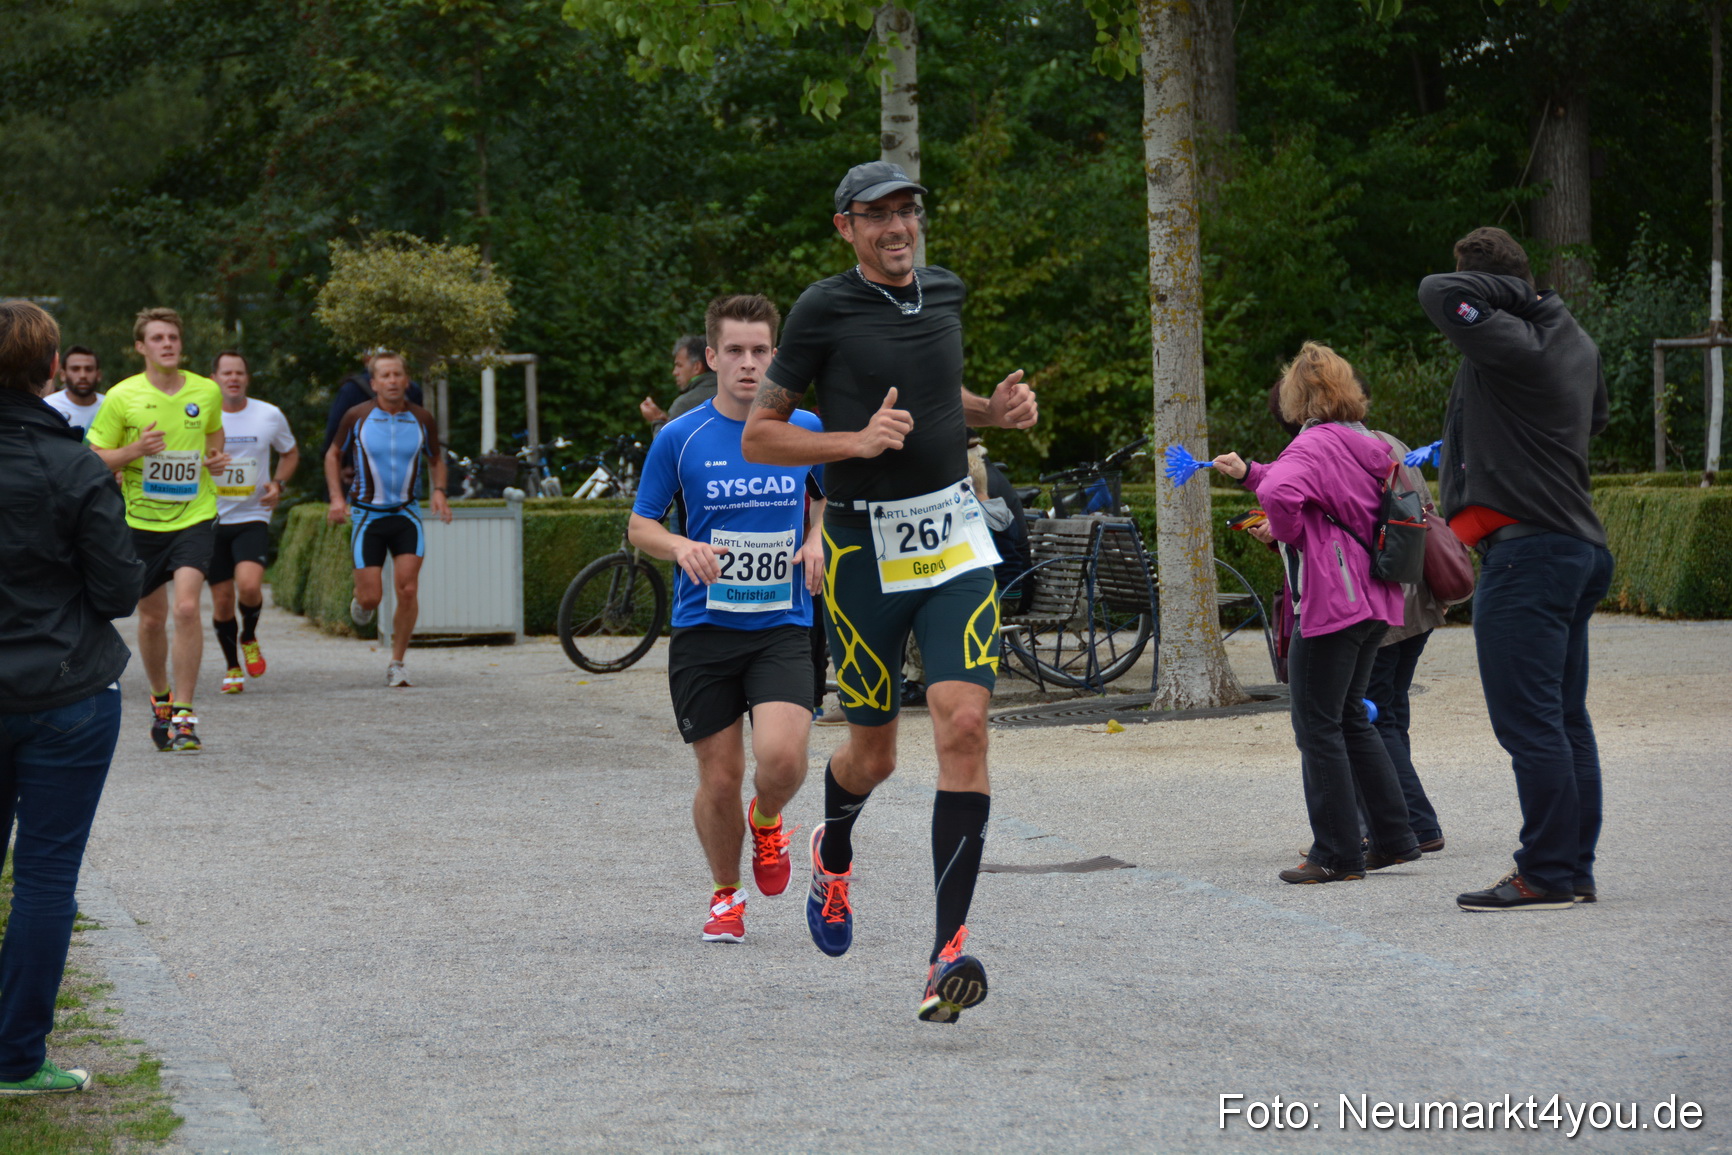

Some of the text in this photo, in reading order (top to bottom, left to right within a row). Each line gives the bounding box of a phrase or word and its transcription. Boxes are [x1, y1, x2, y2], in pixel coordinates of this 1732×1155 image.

[149, 461, 196, 482] 2005
[224, 468, 245, 485] 78
[150, 484, 193, 494] Maximilian
[706, 475, 796, 499] SYSCAD
[704, 498, 798, 511] www.metallbau-cad.de
[910, 498, 953, 517] Neumarkt
[896, 512, 953, 554] 264
[713, 537, 784, 549] PARTL Neumarkt
[718, 550, 788, 582] 2386
[726, 588, 776, 601] Christian
